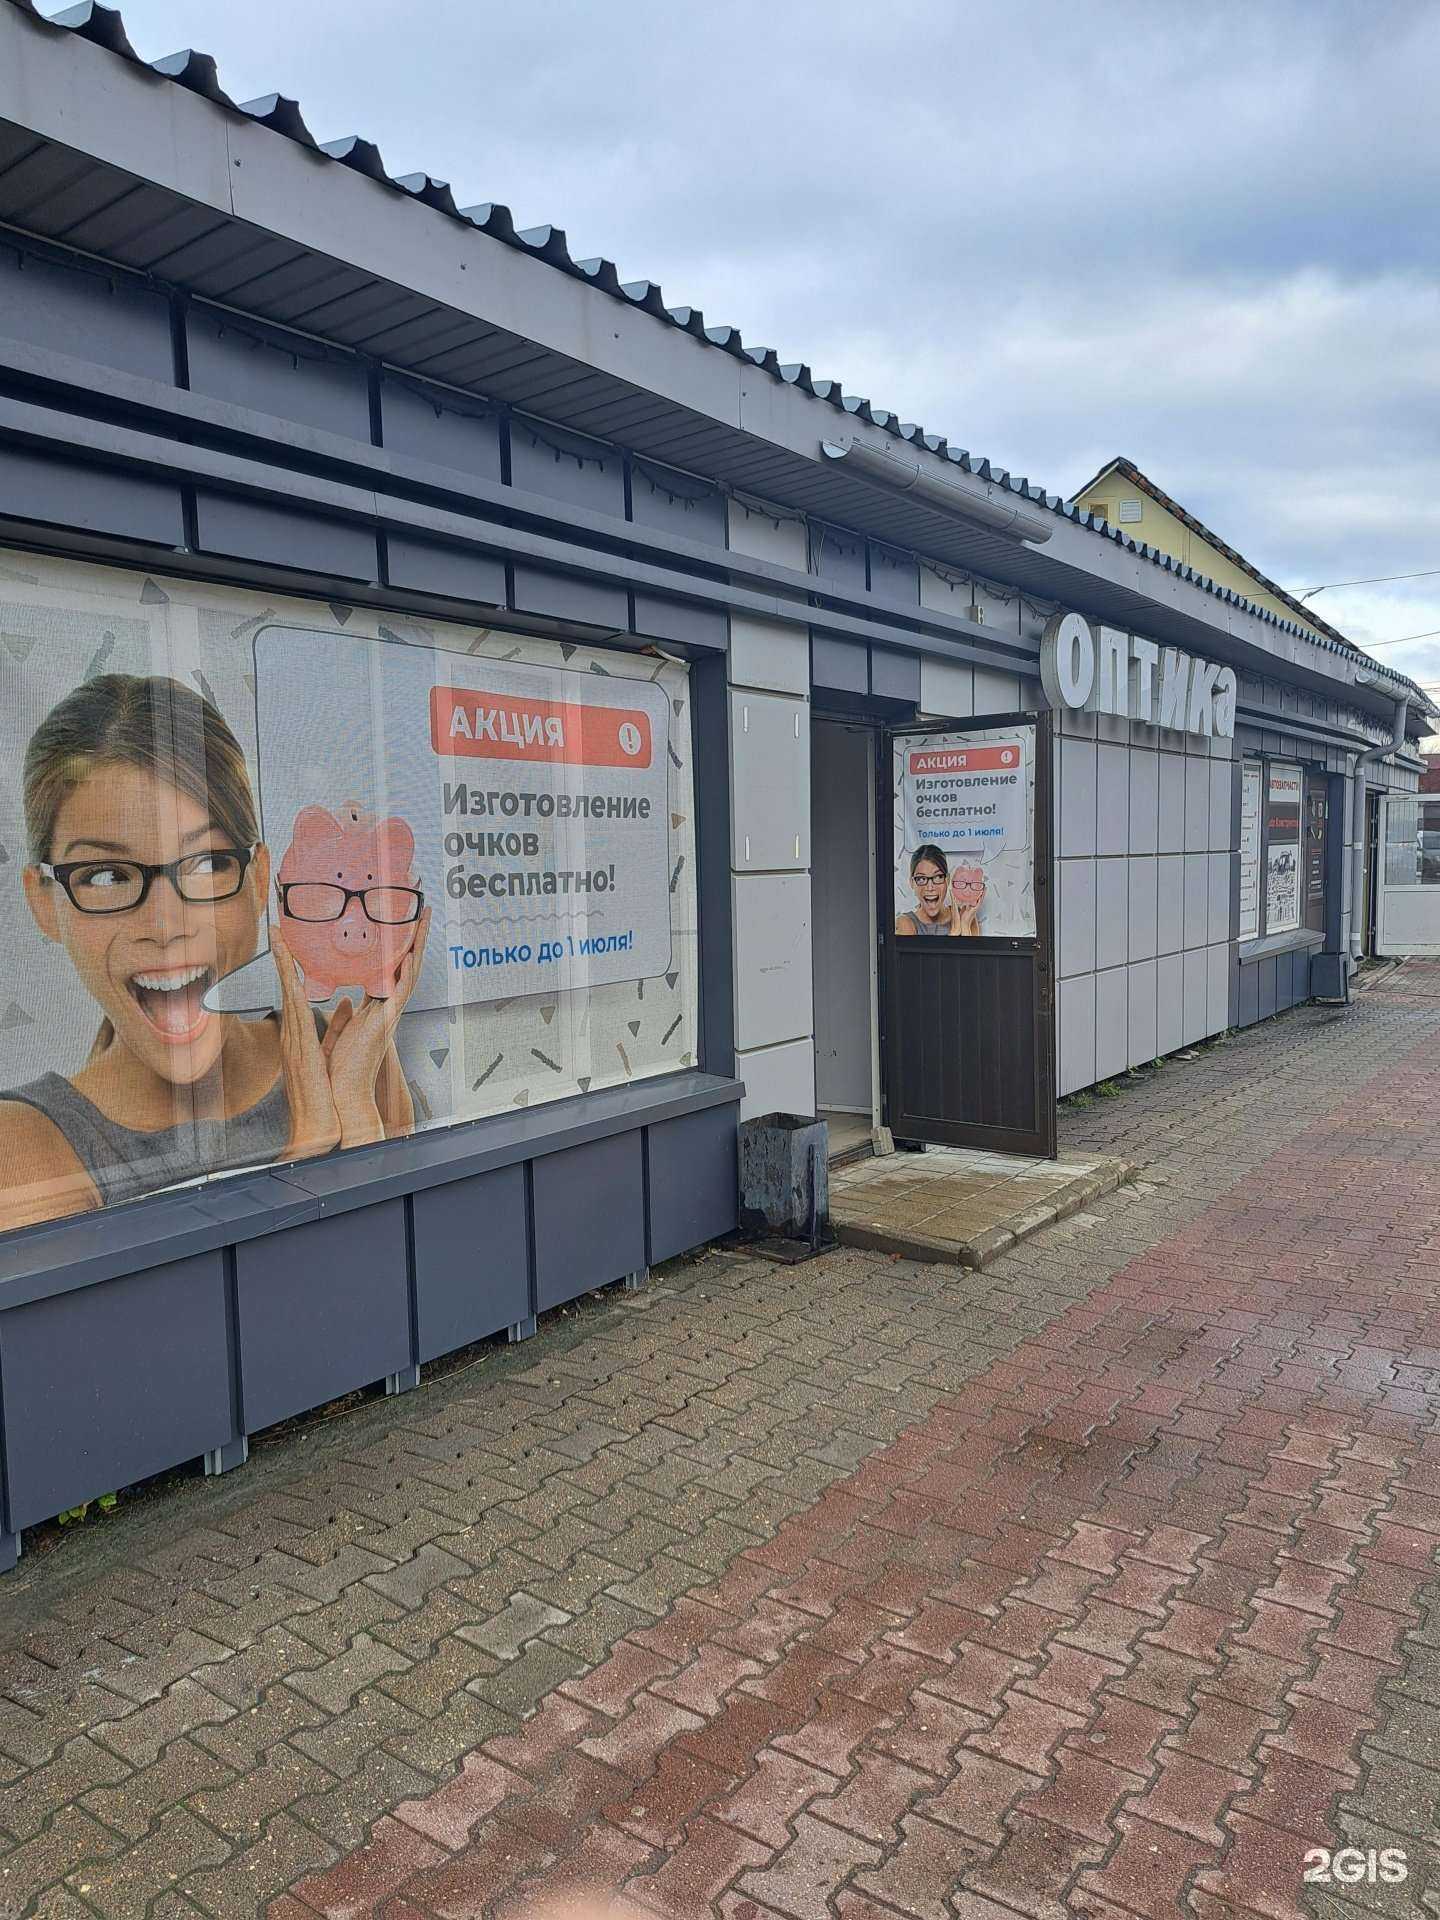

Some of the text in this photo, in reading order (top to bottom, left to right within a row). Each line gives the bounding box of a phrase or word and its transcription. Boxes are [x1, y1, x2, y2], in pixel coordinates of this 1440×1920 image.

[1041, 612, 1237, 738] Оптика
[449, 705, 565, 749] АКЦИЯ
[916, 754, 967, 770] АКЦИЯ
[916, 774, 1018, 790] Изготовление
[443, 782, 651, 820] Изготовление
[916, 792, 958, 804] очков
[916, 803, 997, 818] бесплатно!
[444, 831, 539, 858] очков
[917, 827, 1004, 839] Только до 1 июля!
[446, 864, 616, 899] бесплатно!
[449, 930, 634, 970] Только до 1 июля!
